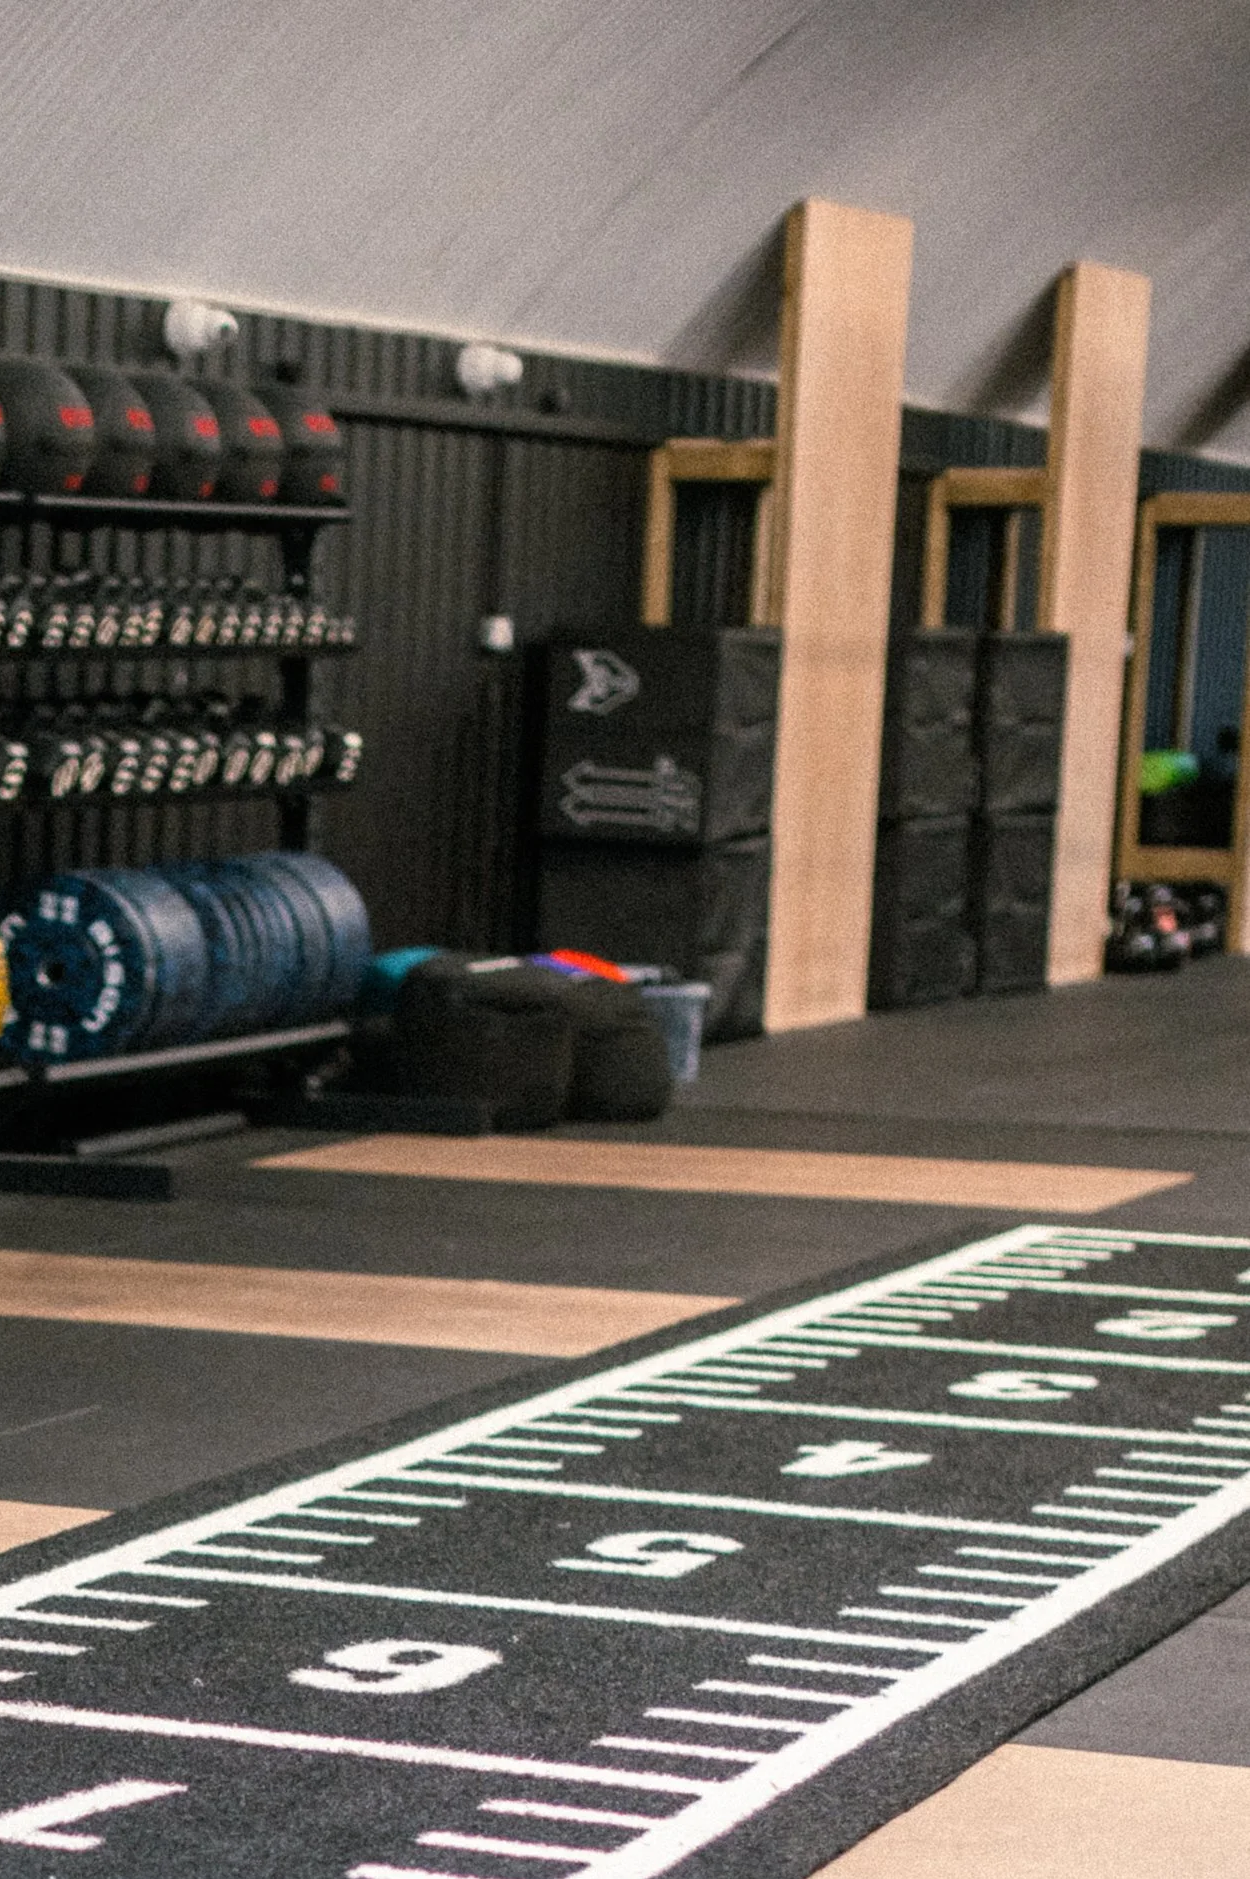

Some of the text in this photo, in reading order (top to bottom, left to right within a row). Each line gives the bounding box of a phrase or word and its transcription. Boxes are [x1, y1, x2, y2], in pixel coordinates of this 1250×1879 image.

[948, 1370, 1099, 1401] 3
[780, 1439, 933, 1478] 4
[550, 1530, 746, 1579] 5
